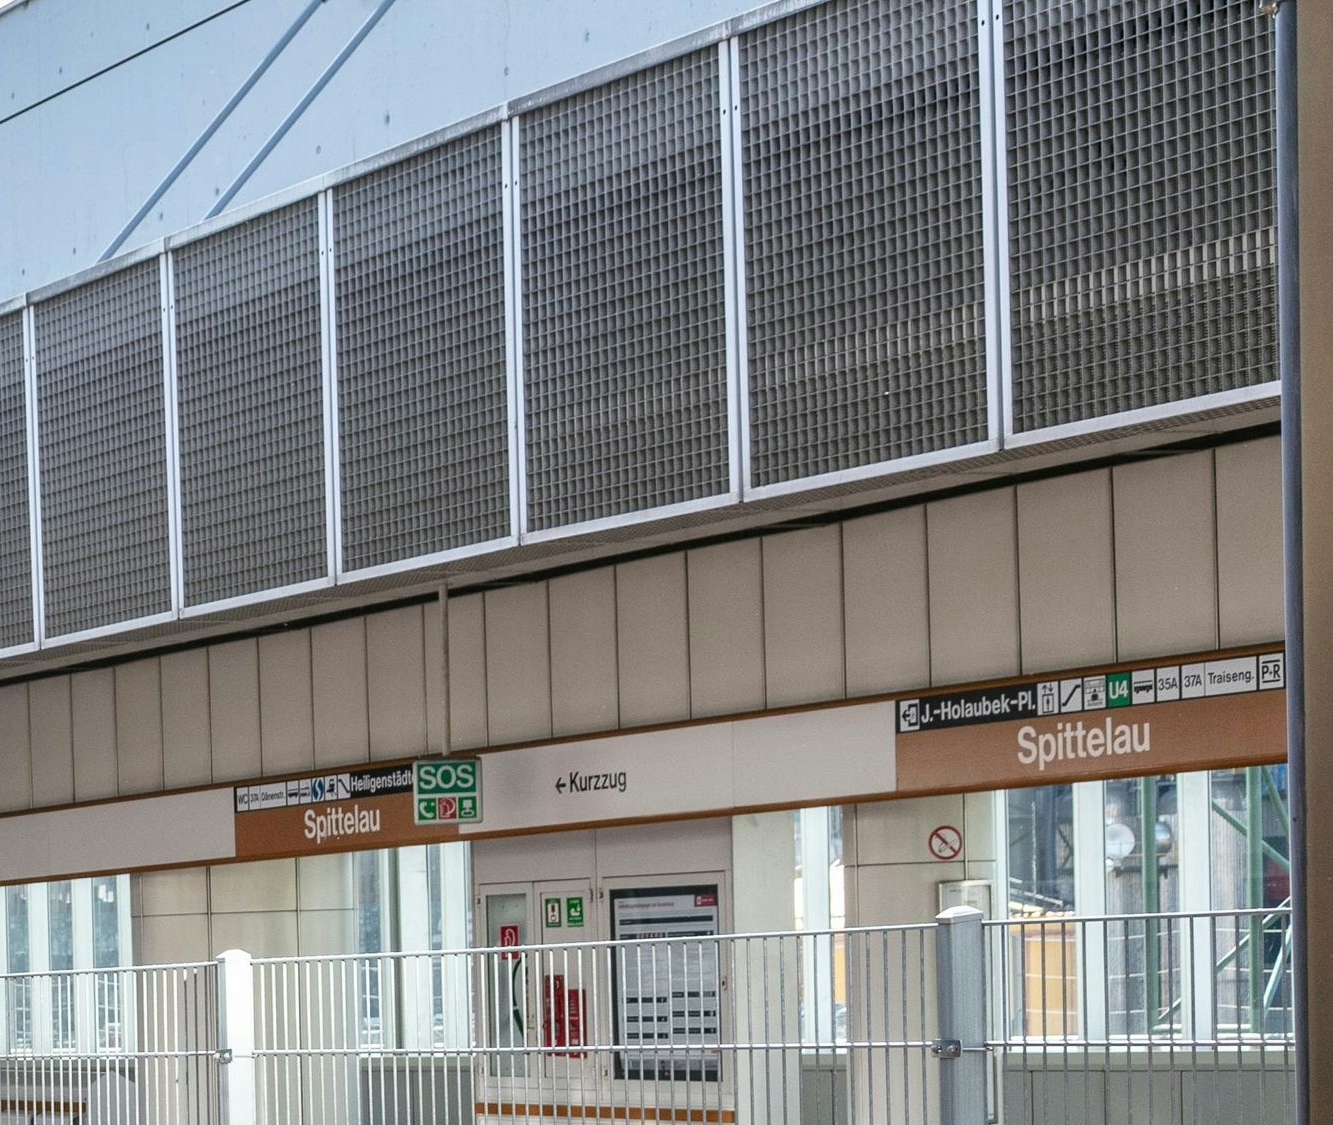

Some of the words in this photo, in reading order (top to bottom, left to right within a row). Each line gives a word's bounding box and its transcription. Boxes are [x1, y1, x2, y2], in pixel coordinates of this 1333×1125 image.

[920, 689, 1036, 724] J.-Holaubek-Pl.
[1108, 679, 1129, 700] U4
[1157, 676, 1179, 692] 35A
[1183, 673, 1203, 688] 37A
[1207, 668, 1255, 686] Traiseng.
[1016, 716, 1151, 772] Spittelau
[418, 763, 475, 790] SOS
[569, 771, 627, 793] Kurzzug
[303, 804, 381, 844] Spittelau
